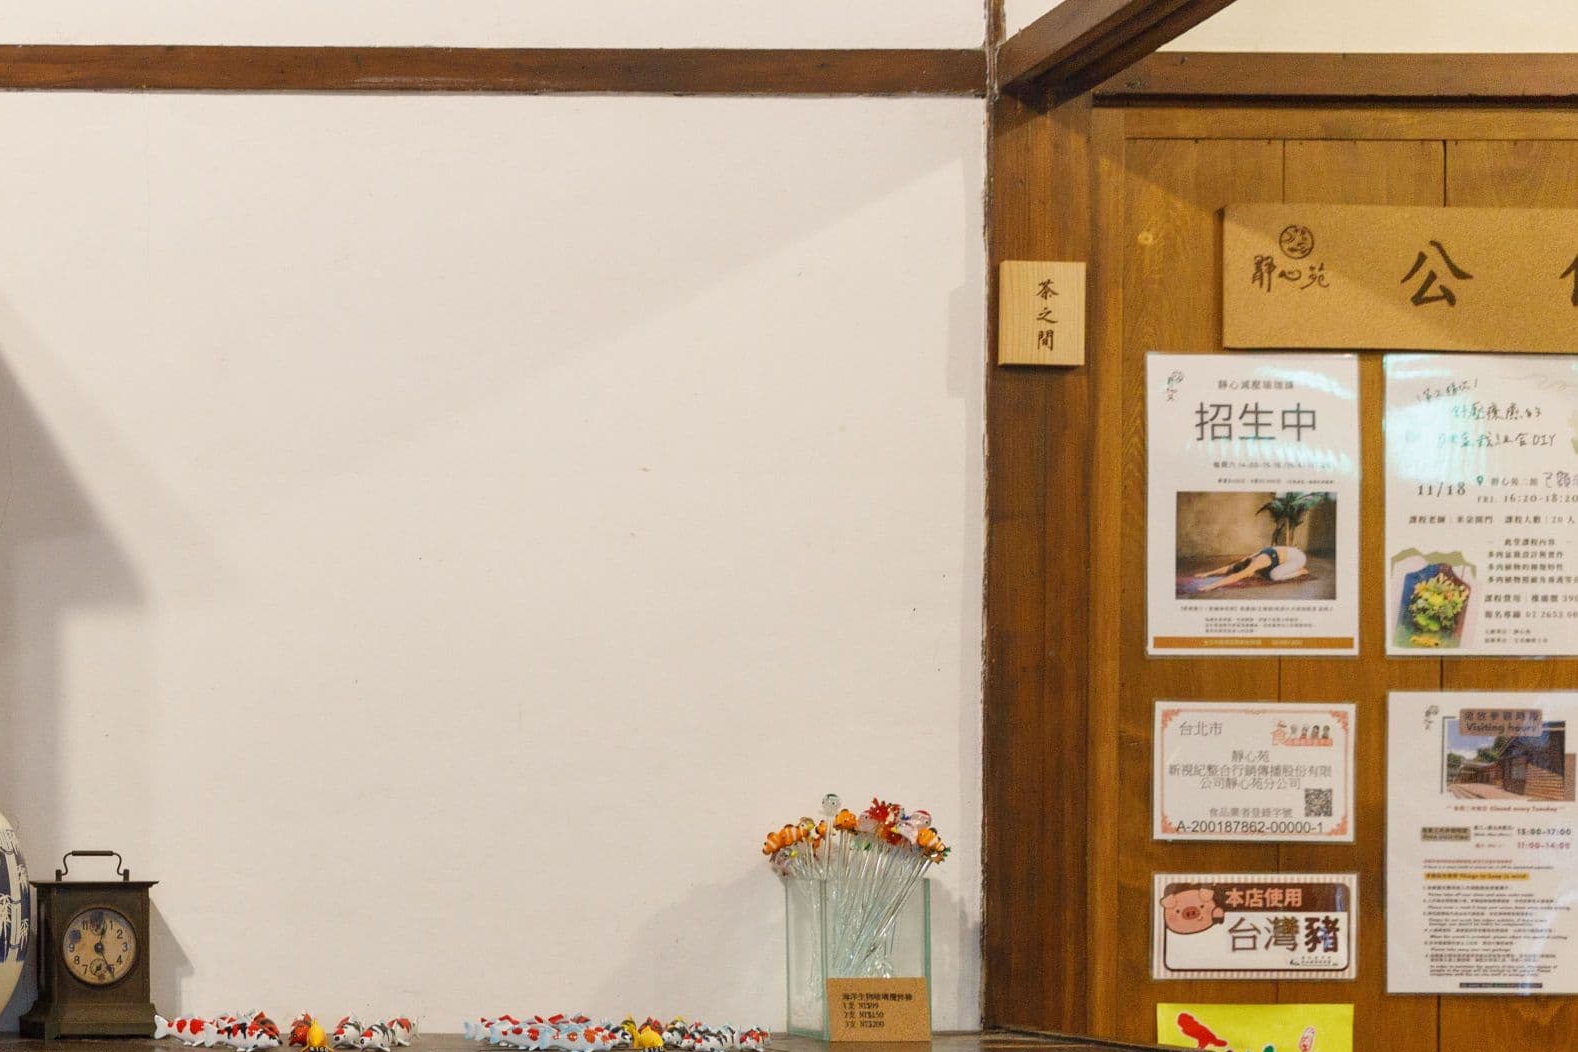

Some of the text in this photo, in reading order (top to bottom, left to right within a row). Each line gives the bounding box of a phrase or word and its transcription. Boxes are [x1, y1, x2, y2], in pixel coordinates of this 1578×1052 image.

[1034, 279, 1060, 352] 茶之間
[1194, 401, 1317, 442] 招生中
[1417, 482, 1467, 497] 11/18
[1179, 720, 1223, 737] 台北市
[1231, 750, 1271, 763] 靜心苑
[1175, 820, 1324, 834] A-200187862-00000-1
[1225, 887, 1303, 908] 本店使用
[1228, 915, 1340, 953] 台灣豬
